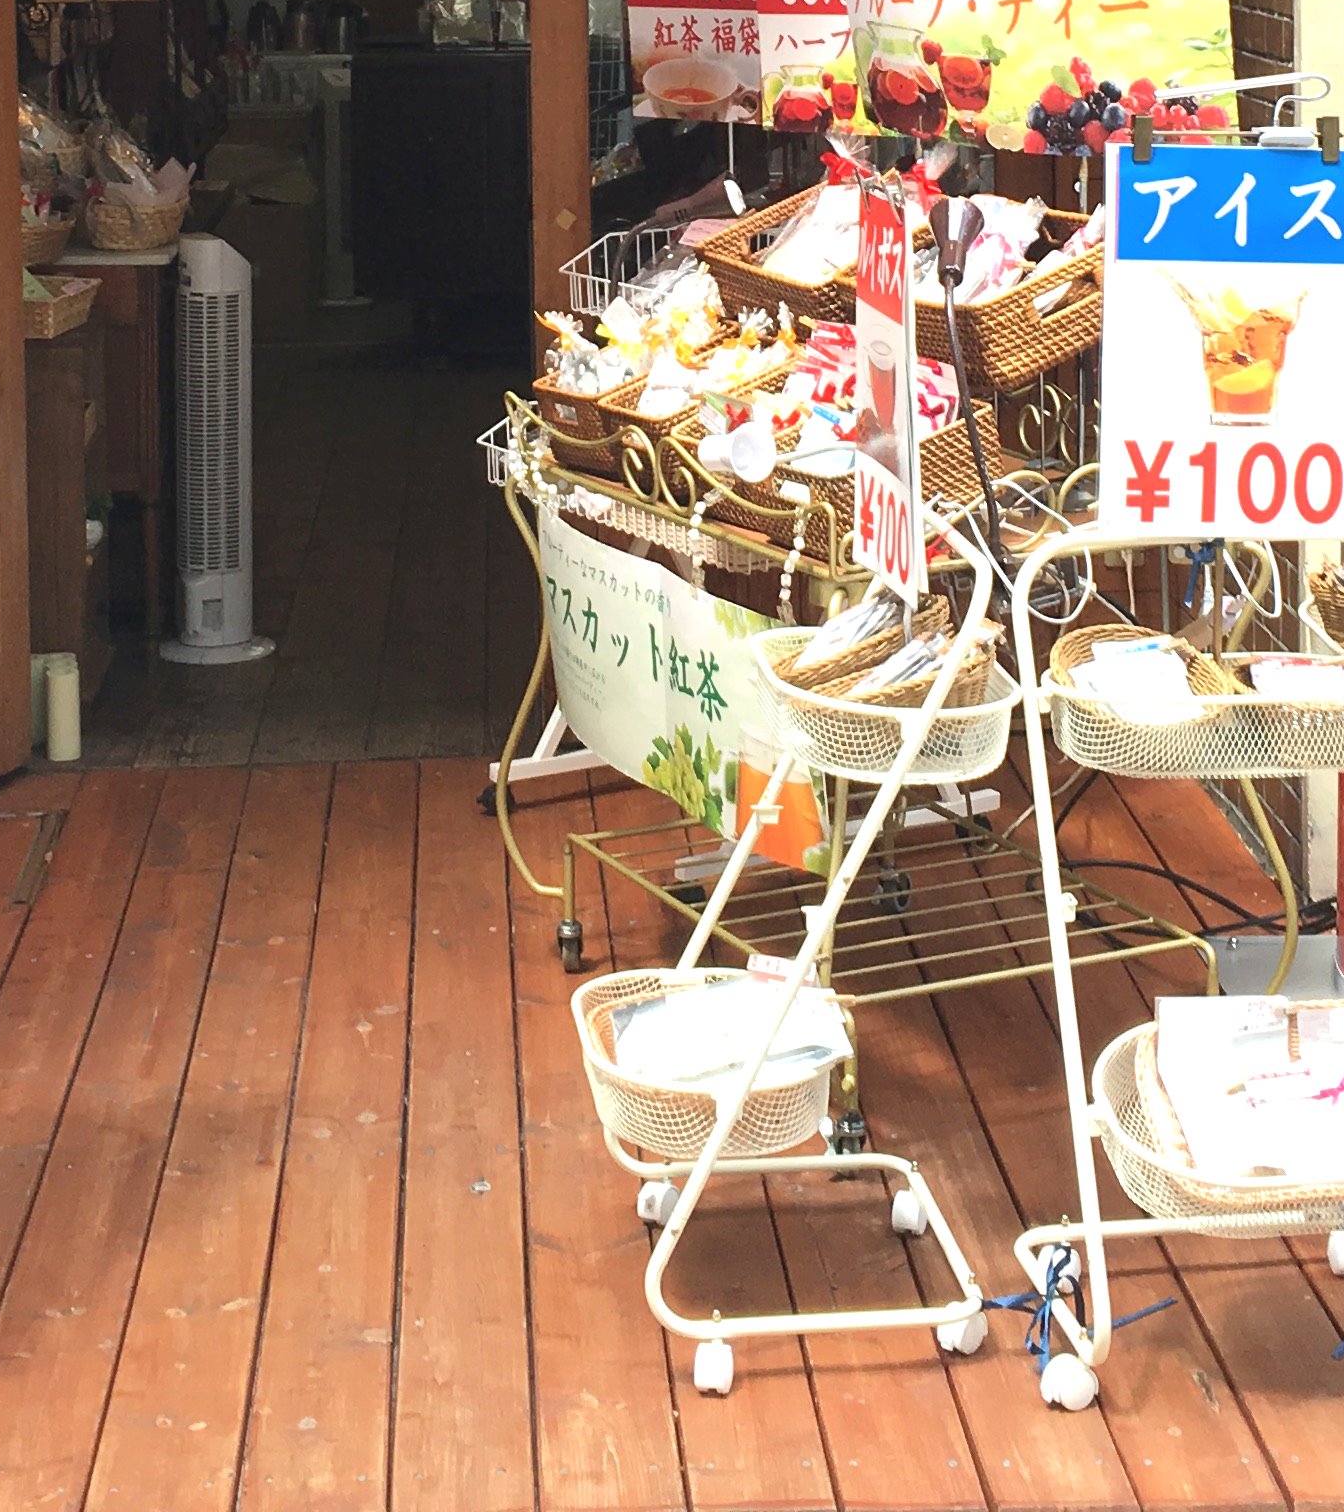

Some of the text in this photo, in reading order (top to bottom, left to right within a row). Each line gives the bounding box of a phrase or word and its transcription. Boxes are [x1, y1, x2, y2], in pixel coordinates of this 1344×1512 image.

[1132, 171, 1343, 248] アイス
[1123, 439, 1344, 525] ¥100
[545, 574, 728, 723] マスカット紅茶
